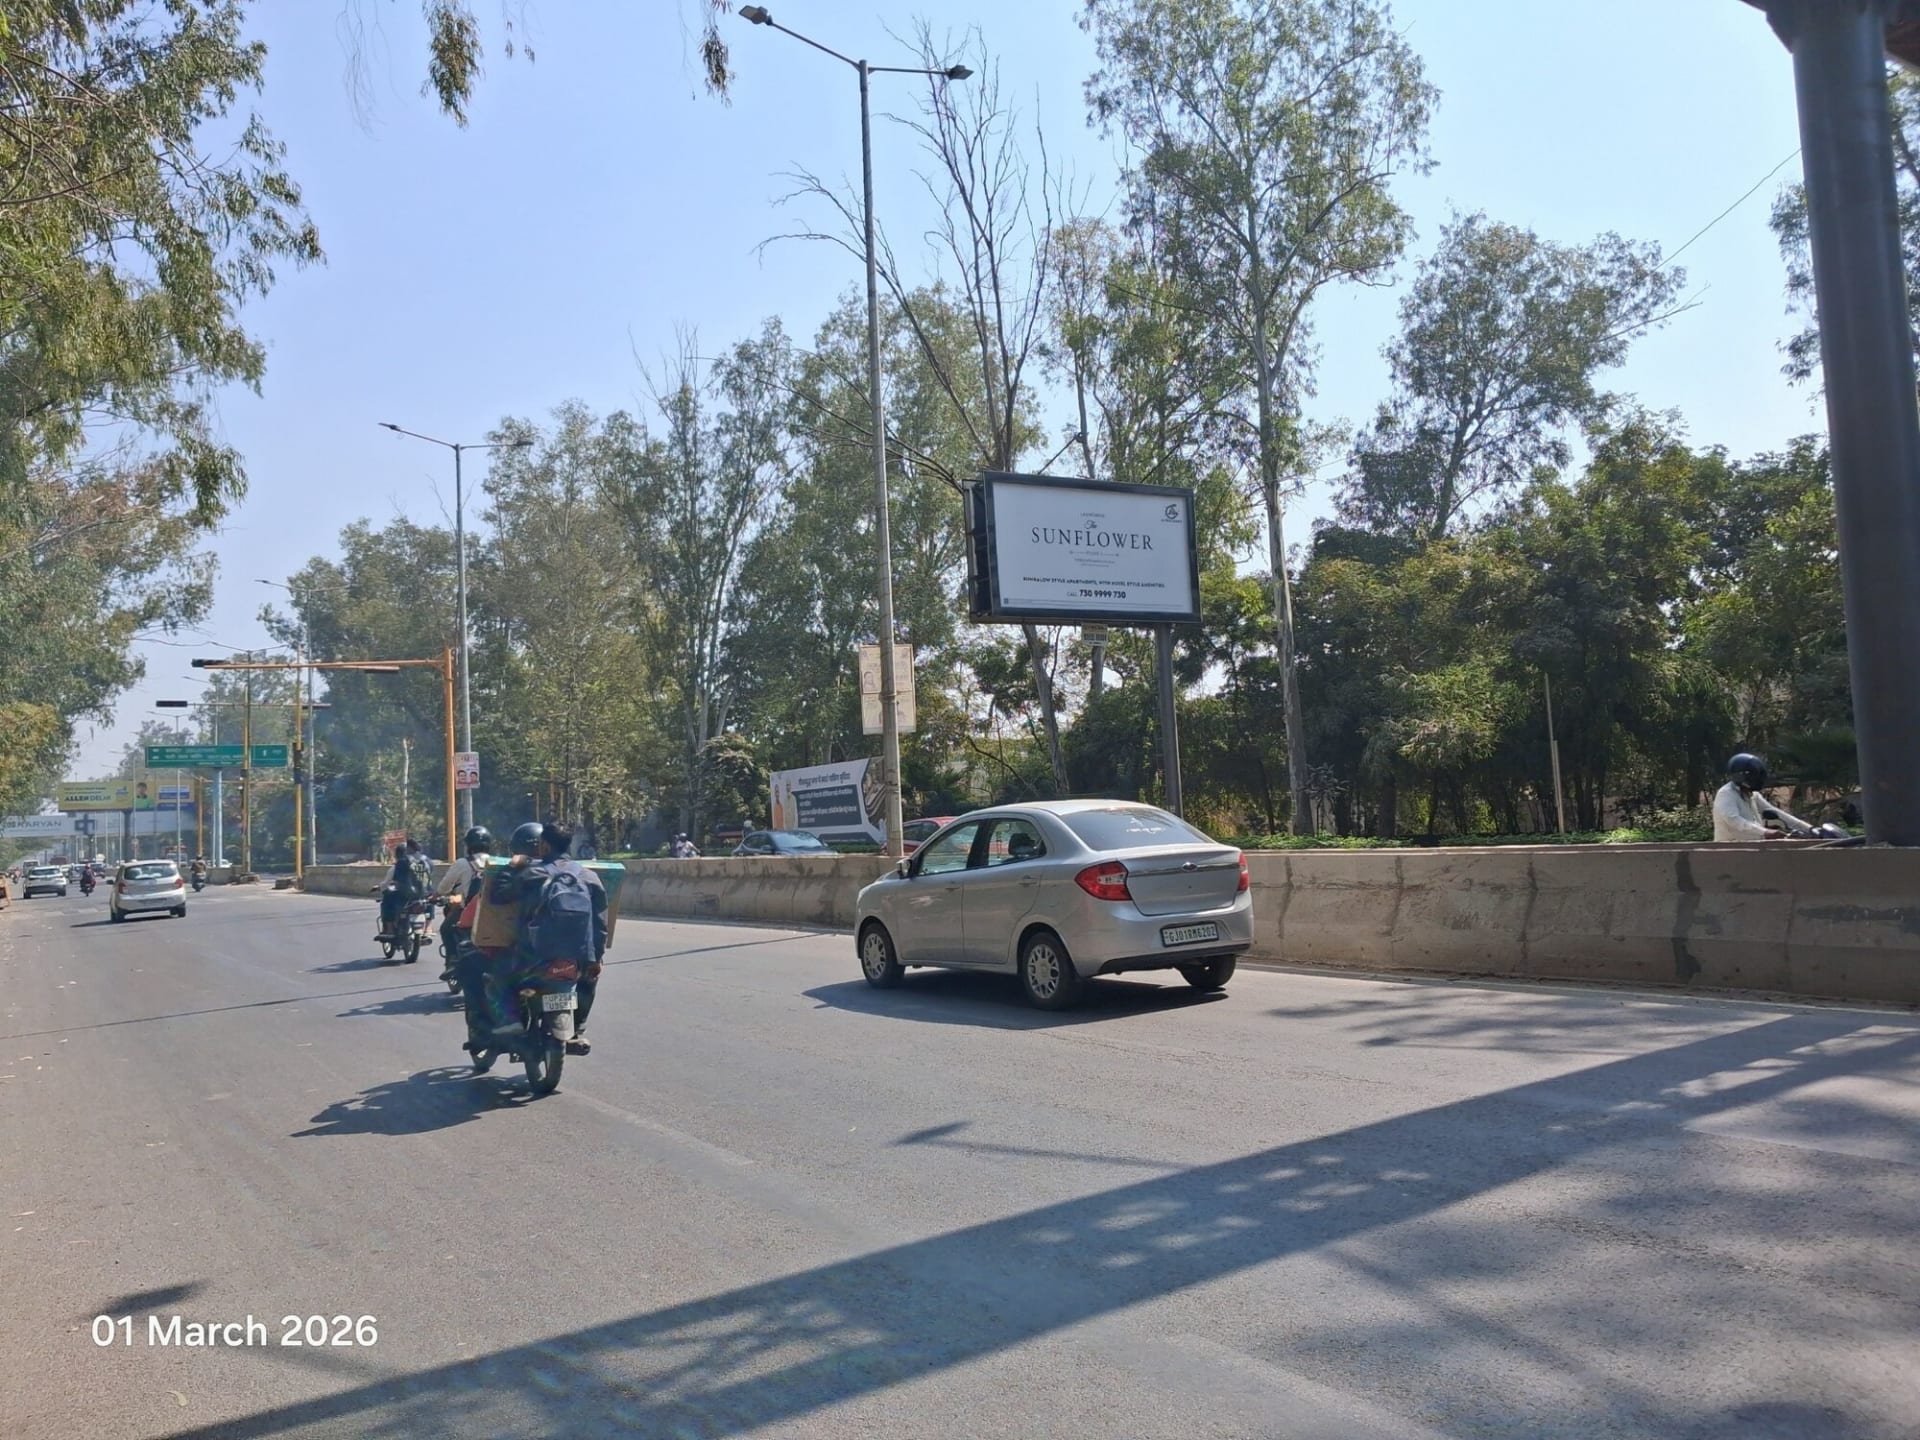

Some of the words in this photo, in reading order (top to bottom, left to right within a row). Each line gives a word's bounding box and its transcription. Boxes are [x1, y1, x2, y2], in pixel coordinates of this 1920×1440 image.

[1031, 526, 1153, 550] SUNFLOWER
[1079, 589, 1093, 598] 730
[1094, 589, 1112, 598] 9999
[1113, 590, 1126, 599] 730
